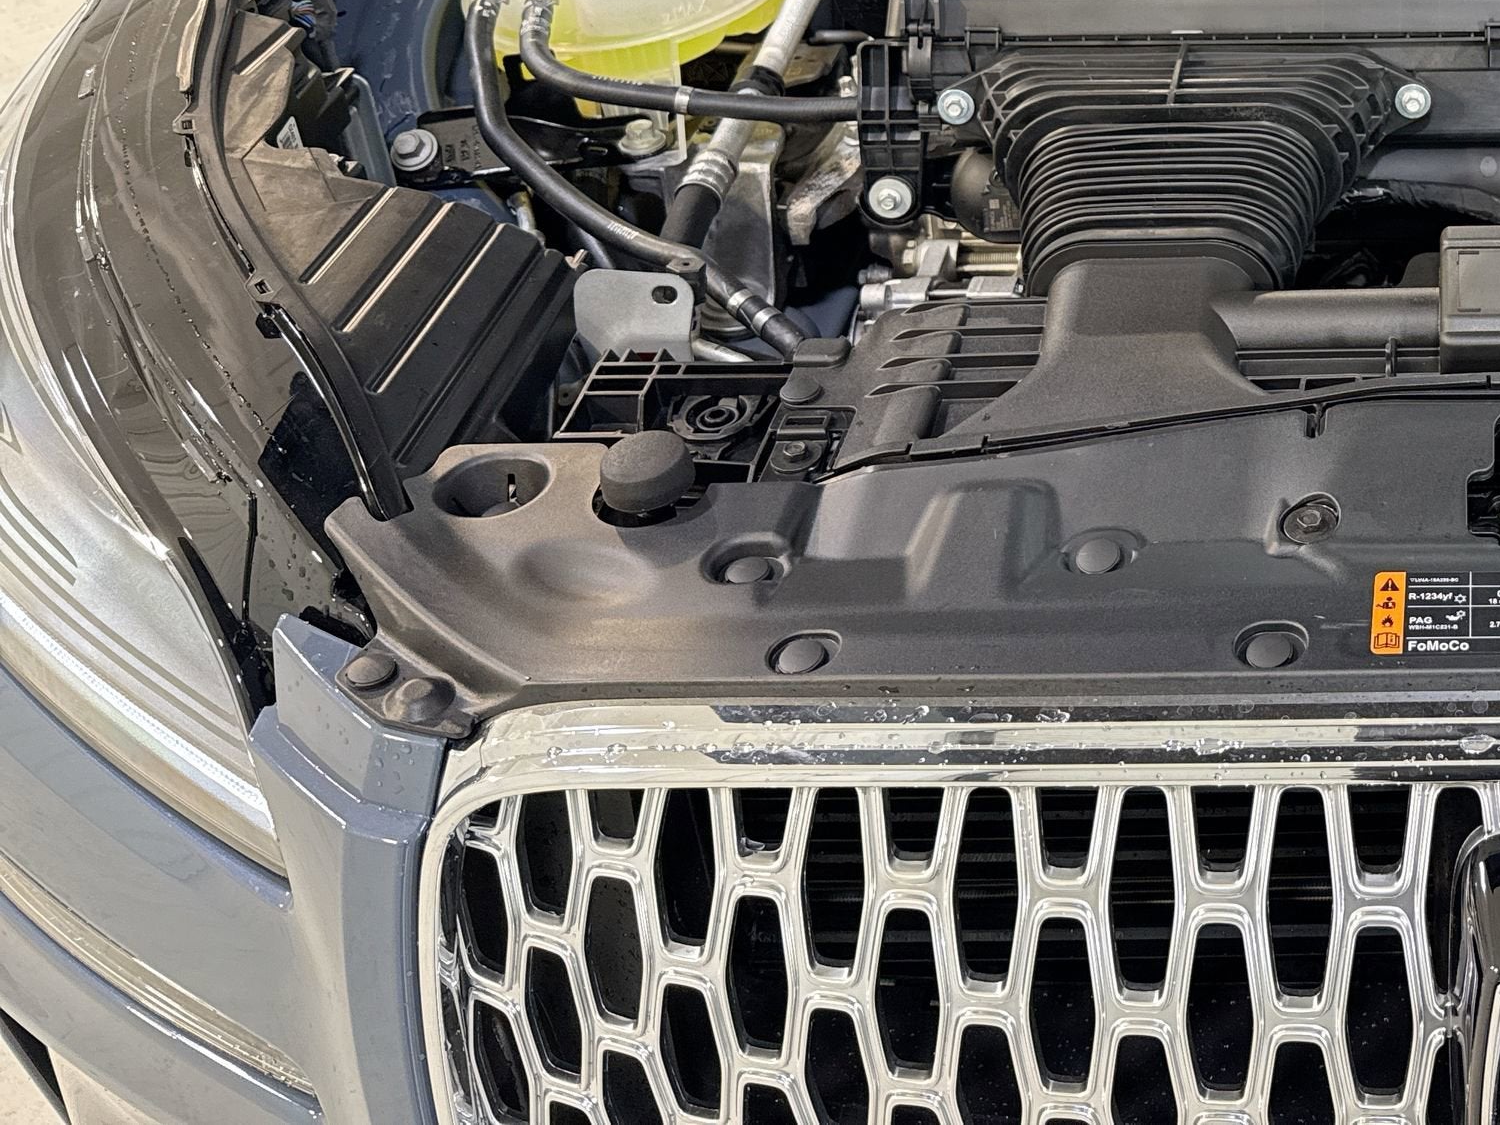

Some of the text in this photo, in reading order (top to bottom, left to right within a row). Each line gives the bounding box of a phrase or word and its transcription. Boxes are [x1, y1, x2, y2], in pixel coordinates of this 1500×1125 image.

[1408, 592, 1453, 601] R-1234yf
[1408, 616, 1433, 624] PAG
[1407, 640, 1470, 651] FoMoCo
